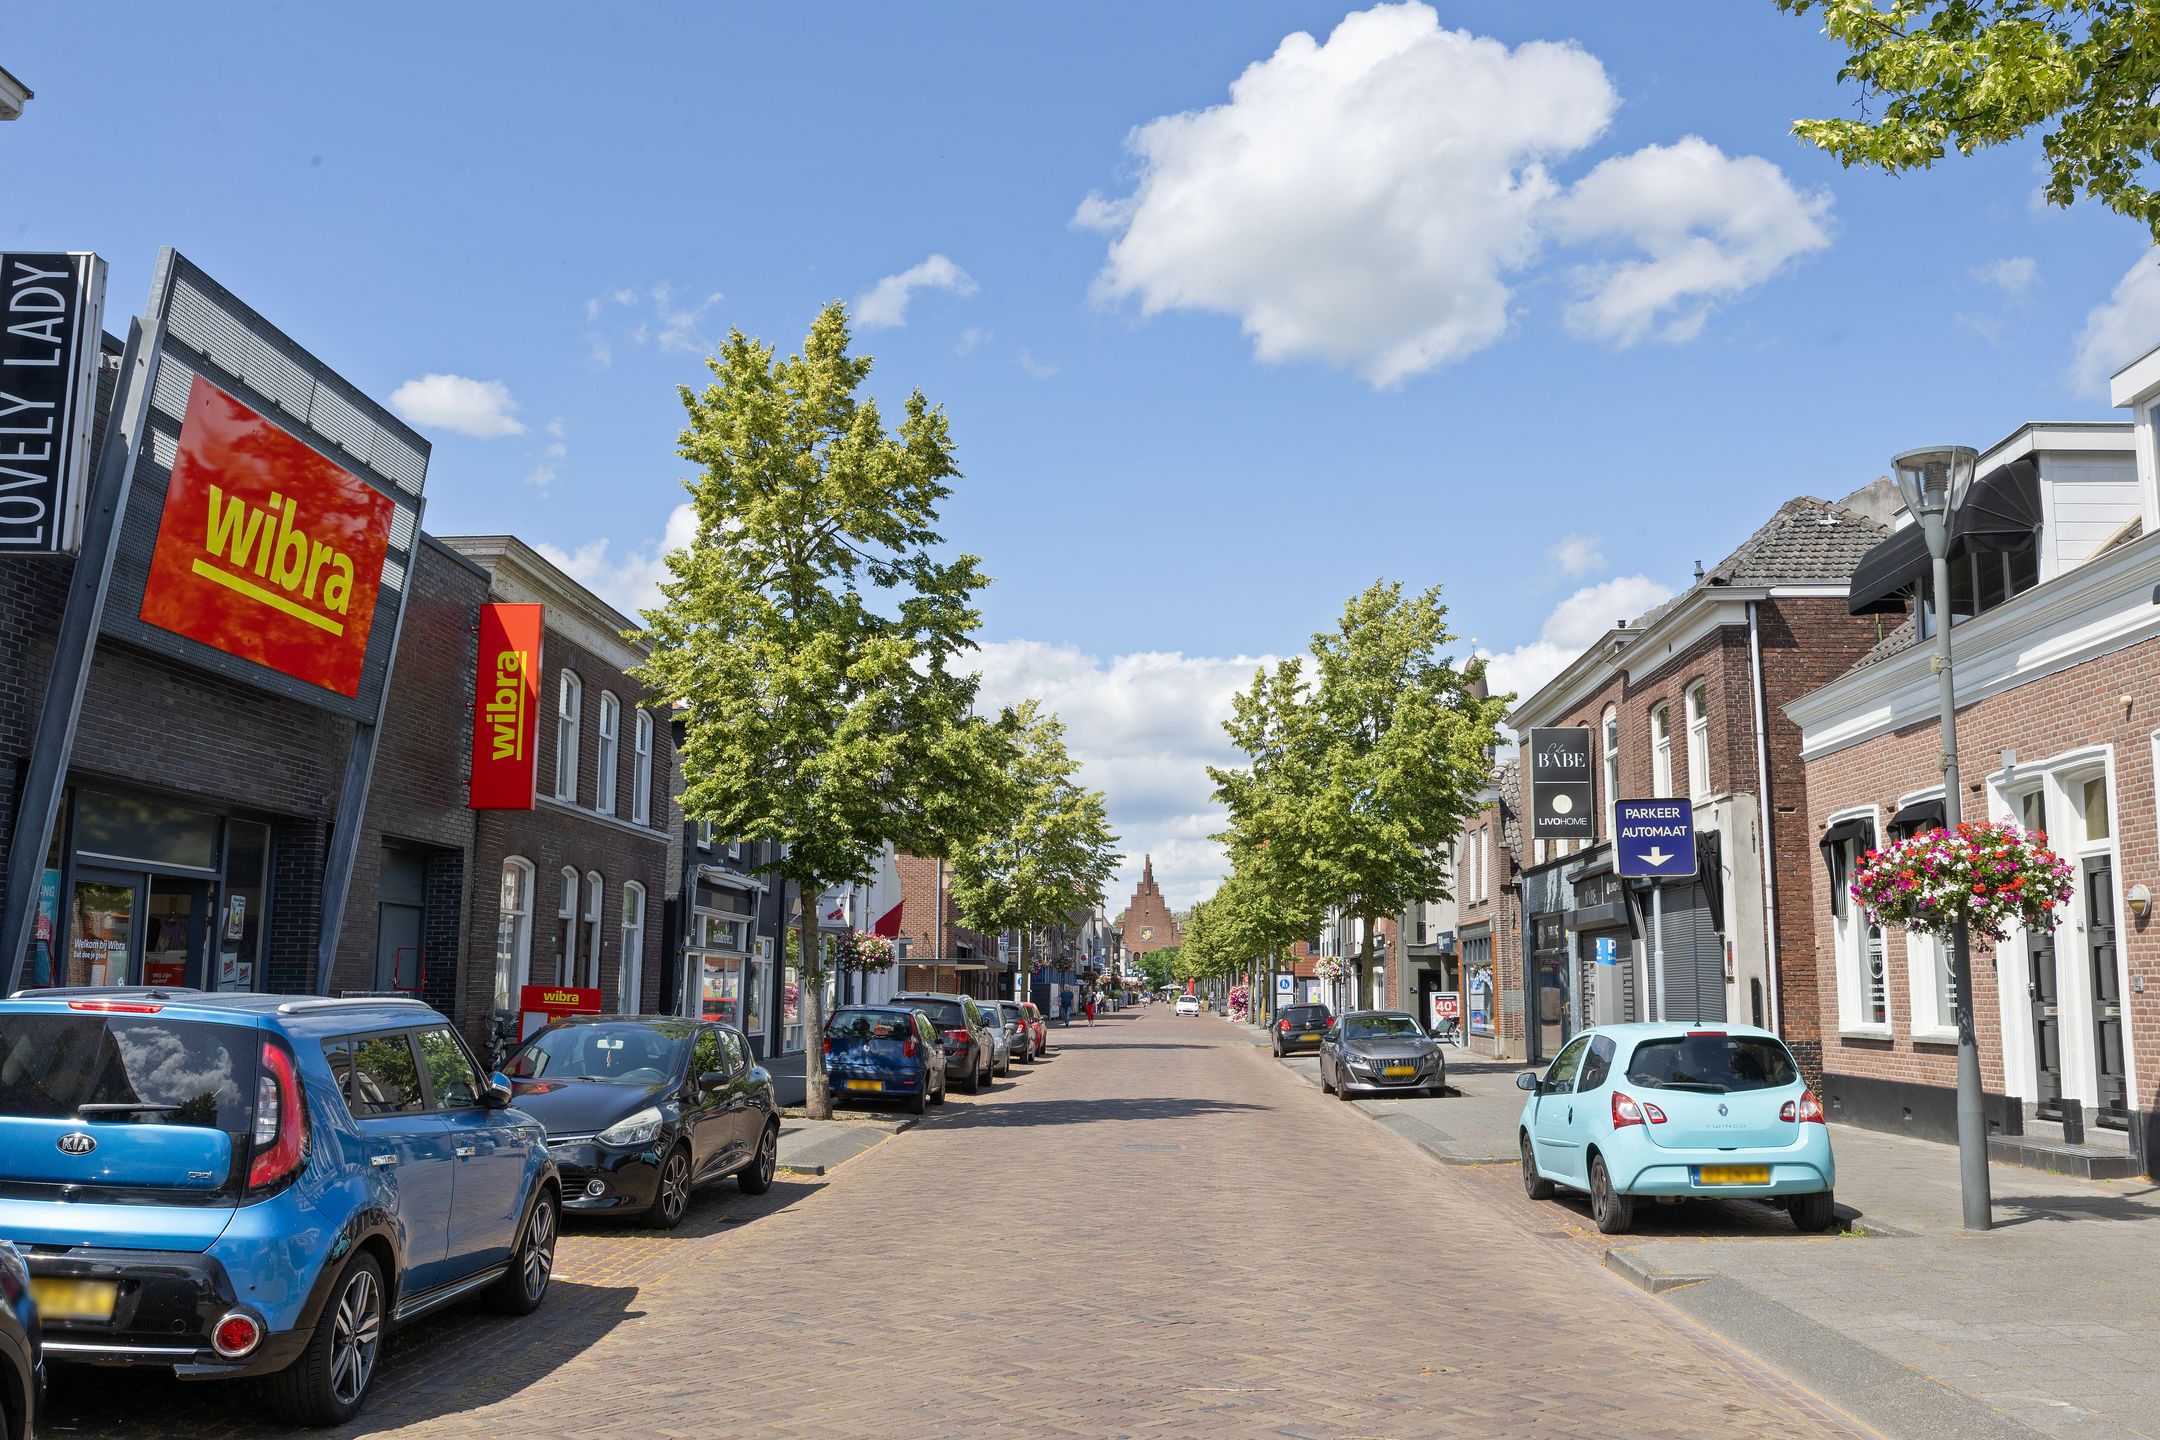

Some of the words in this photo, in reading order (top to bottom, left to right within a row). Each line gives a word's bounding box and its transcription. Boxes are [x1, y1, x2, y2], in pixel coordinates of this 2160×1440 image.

[3, 261, 69, 366] LADY
[0, 391, 55, 544] LOVELY
[206, 484, 354, 616] wibra
[486, 651, 520, 760] wibra
[1625, 807, 1681, 819] PARKEER
[1538, 817, 1588, 826] LIVOHOME
[1621, 825, 1687, 838] AUTOMAAT
[74, 939, 99, 949] Welkom
[99, 940, 108, 951] bij
[108, 940, 126, 951] Wibra
[543, 990, 579, 1003] wibra
[1436, 1001, 1457, 1011] 40%
[62, 1137, 90, 1151] KIA
